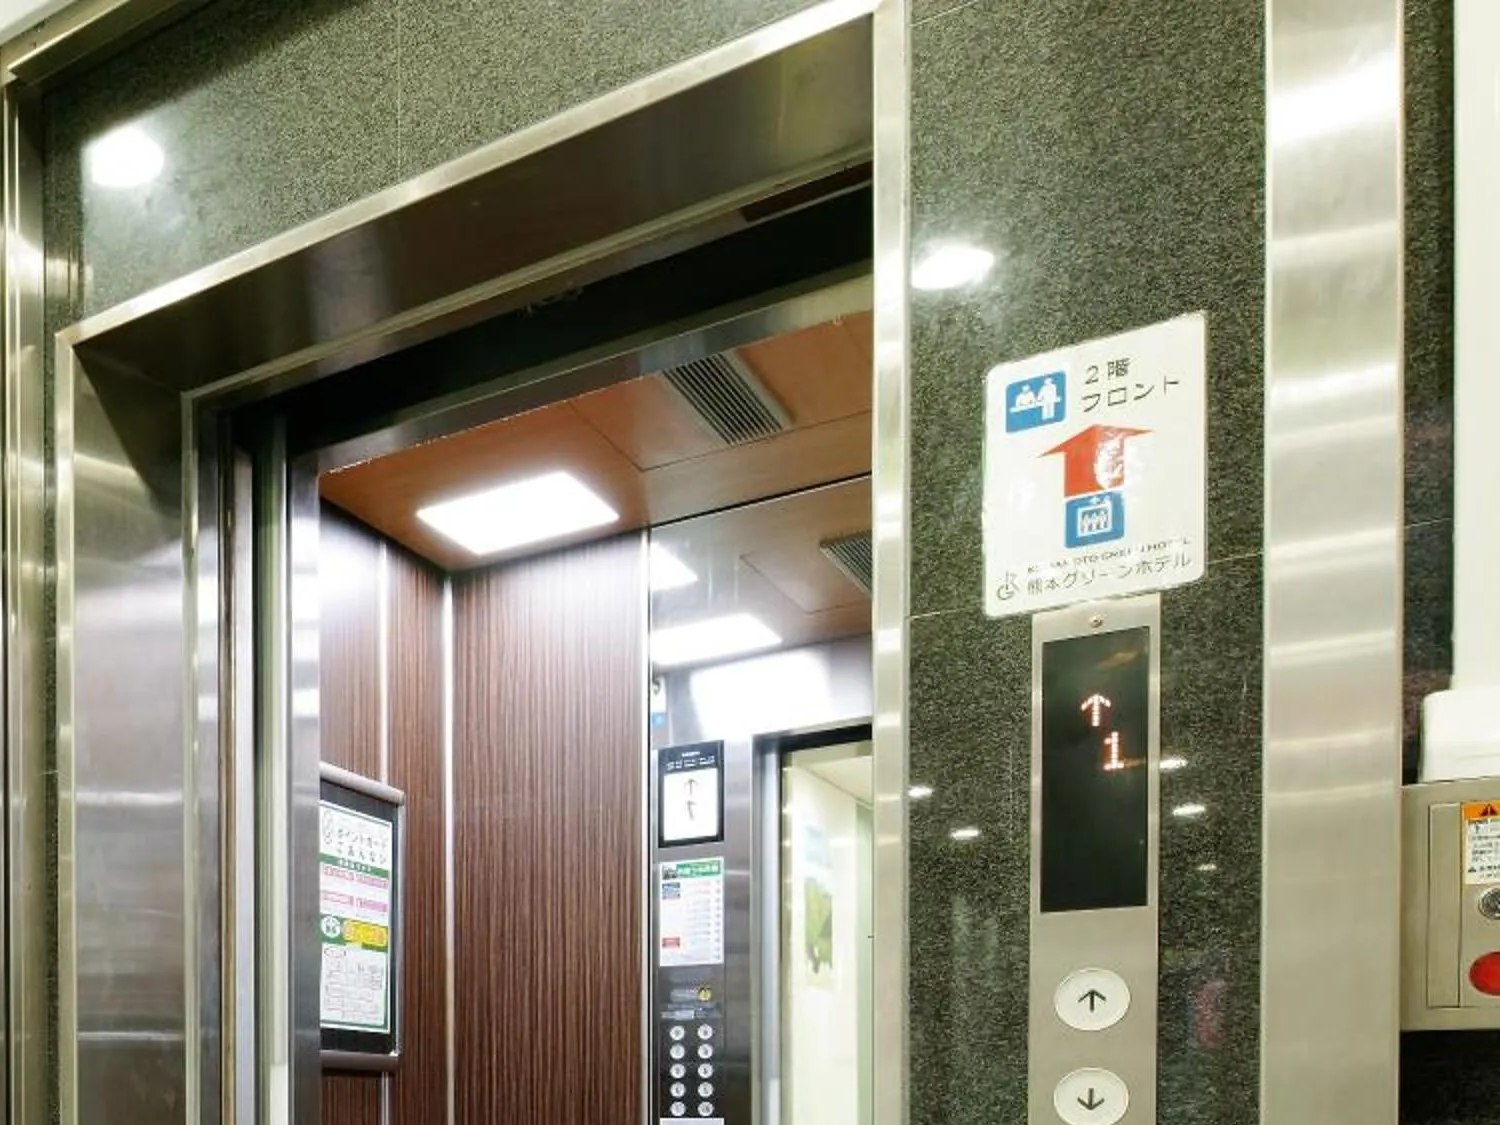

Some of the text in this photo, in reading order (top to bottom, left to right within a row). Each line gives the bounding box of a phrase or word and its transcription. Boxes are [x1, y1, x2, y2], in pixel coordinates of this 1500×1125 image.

[1085, 357, 1131, 384] 2階
[1081, 375, 1180, 413] フロント
[1103, 731, 1125, 772] 1
